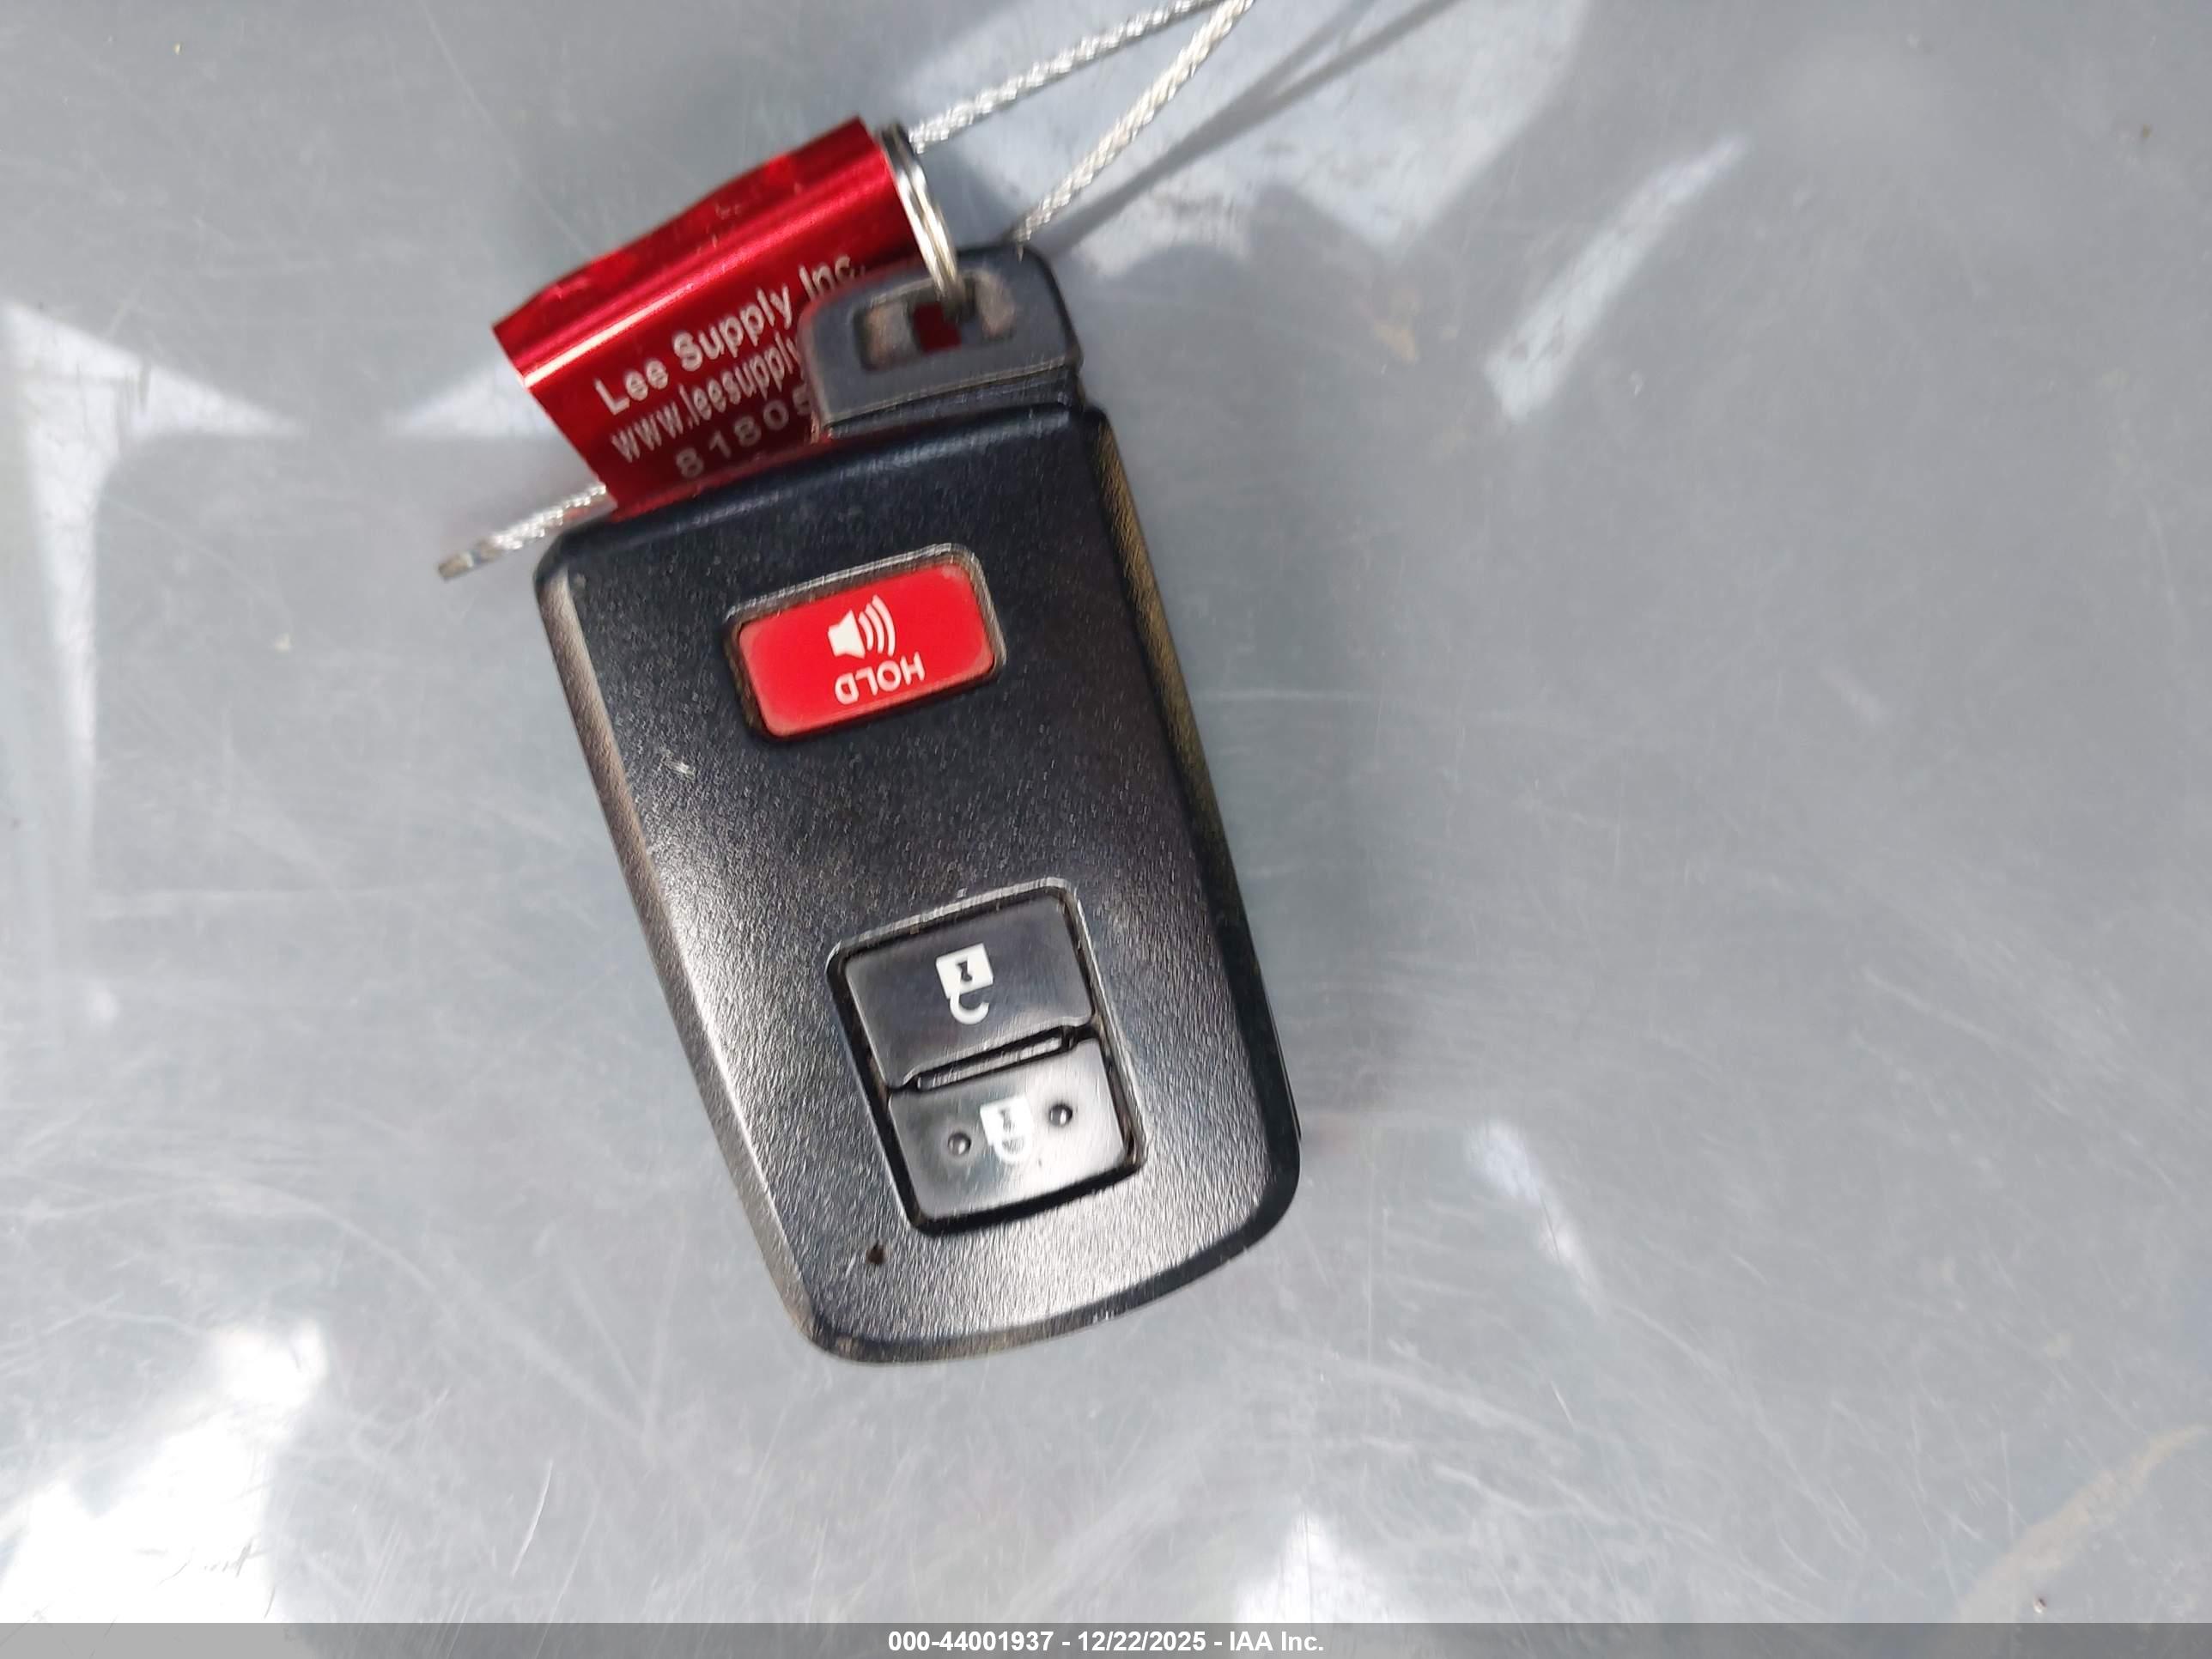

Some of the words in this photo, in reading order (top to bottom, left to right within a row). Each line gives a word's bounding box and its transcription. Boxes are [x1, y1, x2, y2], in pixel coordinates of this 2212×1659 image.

[594, 357, 670, 416] Lee
[672, 282, 793, 372] Supply
[835, 651, 925, 705] HOLD
